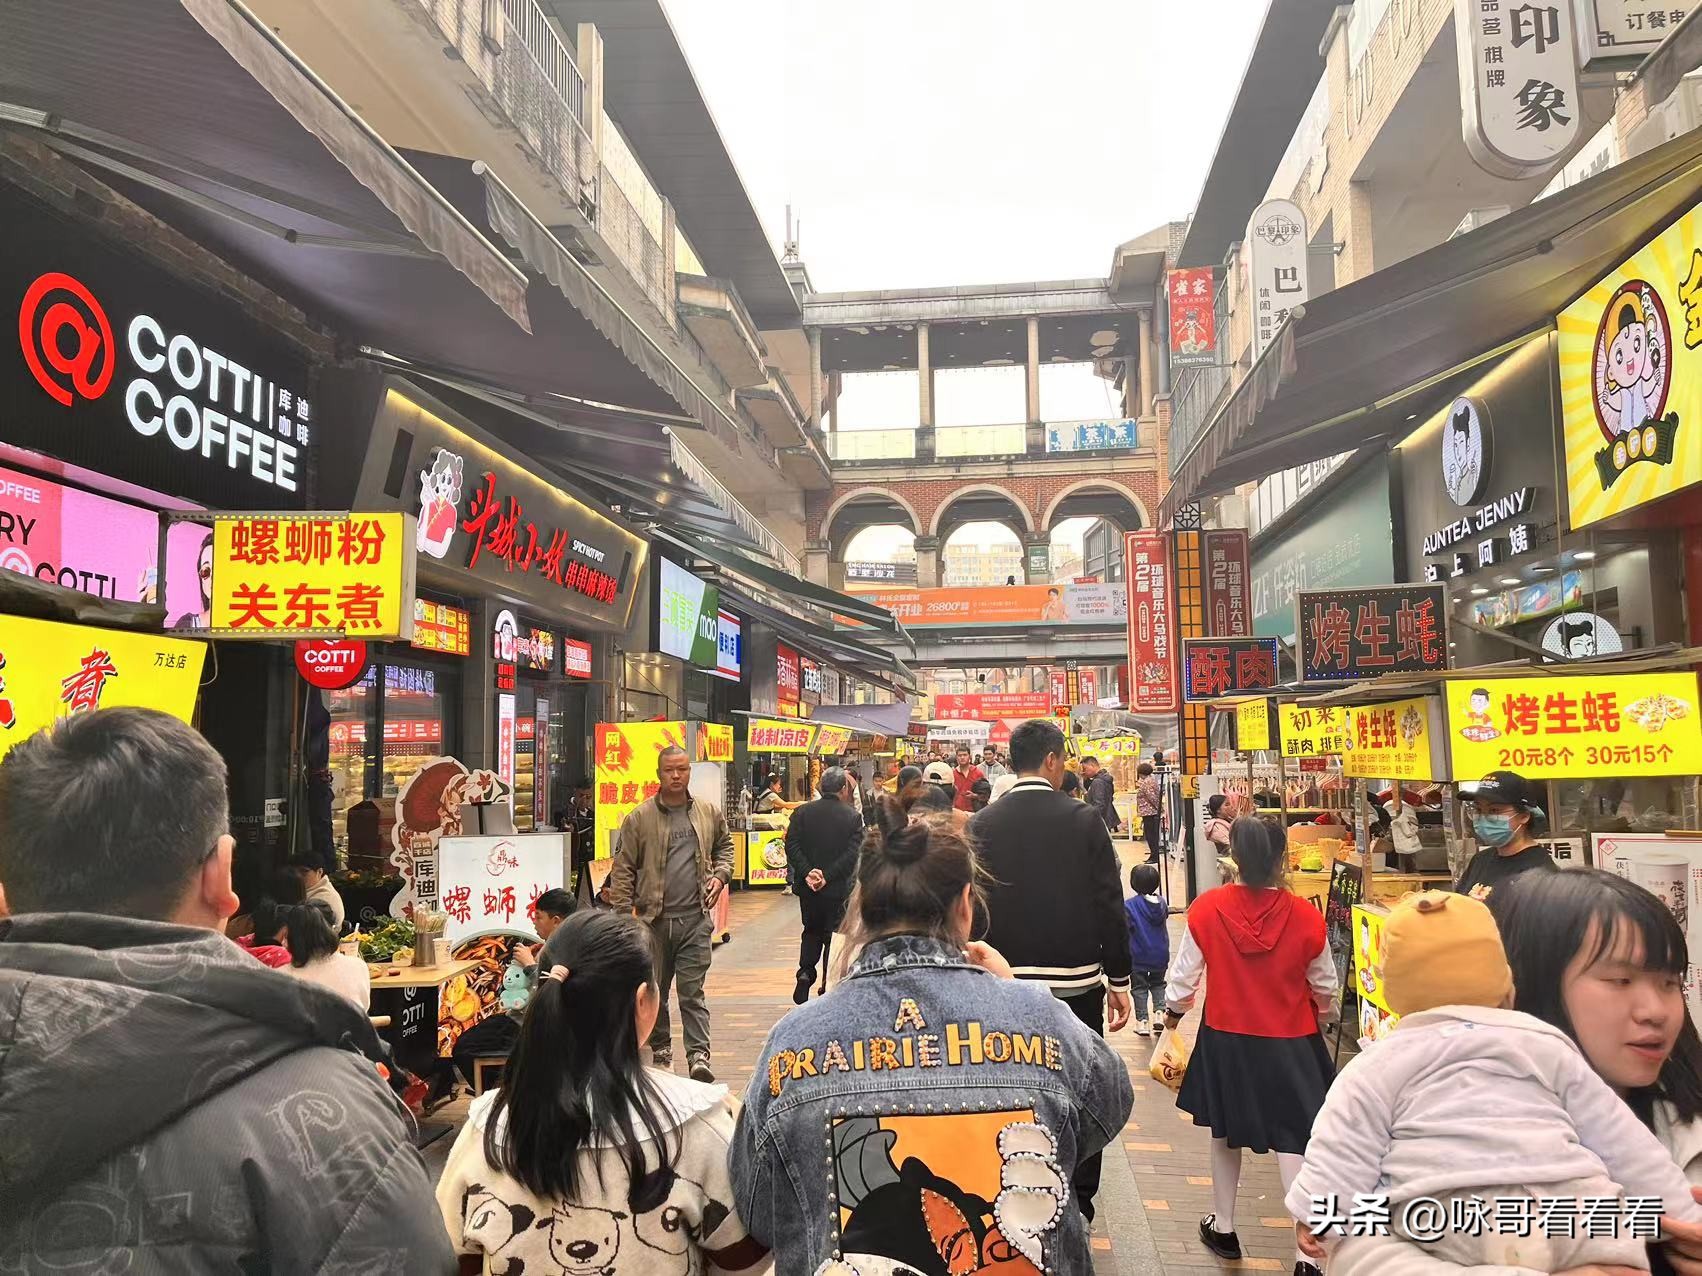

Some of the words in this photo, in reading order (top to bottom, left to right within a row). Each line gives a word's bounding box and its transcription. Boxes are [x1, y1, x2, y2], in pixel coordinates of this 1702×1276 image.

[1509, 3, 1571, 132] 印象
[128, 314, 263, 429] COTTI
[278, 387, 310, 421] 库迪
[125, 377, 298, 493] COFFEE
[278, 414, 310, 446] 咖啡
[229, 520, 387, 567] 螺蛳粉
[1422, 516, 1472, 557] AUNTEA
[1475, 487, 1527, 531] JENNY
[1135, 552, 1151, 593] 第2届
[1424, 523, 1529, 588] 沪上阿姨
[228, 583, 385, 630] 关东煮
[1150, 564, 1168, 659] 环球音乐大马戏节
[1227, 561, 1244, 637] 环球音乐大马
[304, 649, 355, 665] COTTI
[1310, 597, 1439, 670] 烤生蚝
[153, 652, 188, 669] 万达店
[314, 665, 345, 673] COFFEE
[1189, 645, 1274, 695] 酥肉
[1356, 709, 1397, 750] 烤生蚝
[1502, 692, 1621, 736] 烤生蚝
[605, 731, 621, 766] 网红
[1498, 746, 1575, 767] 20元8个
[1586, 743, 1674, 765] 30元15个
[894, 998, 926, 1032] A
[768, 1034, 942, 1097] PRAIRIE
[945, 1022, 1063, 1071] HOME
